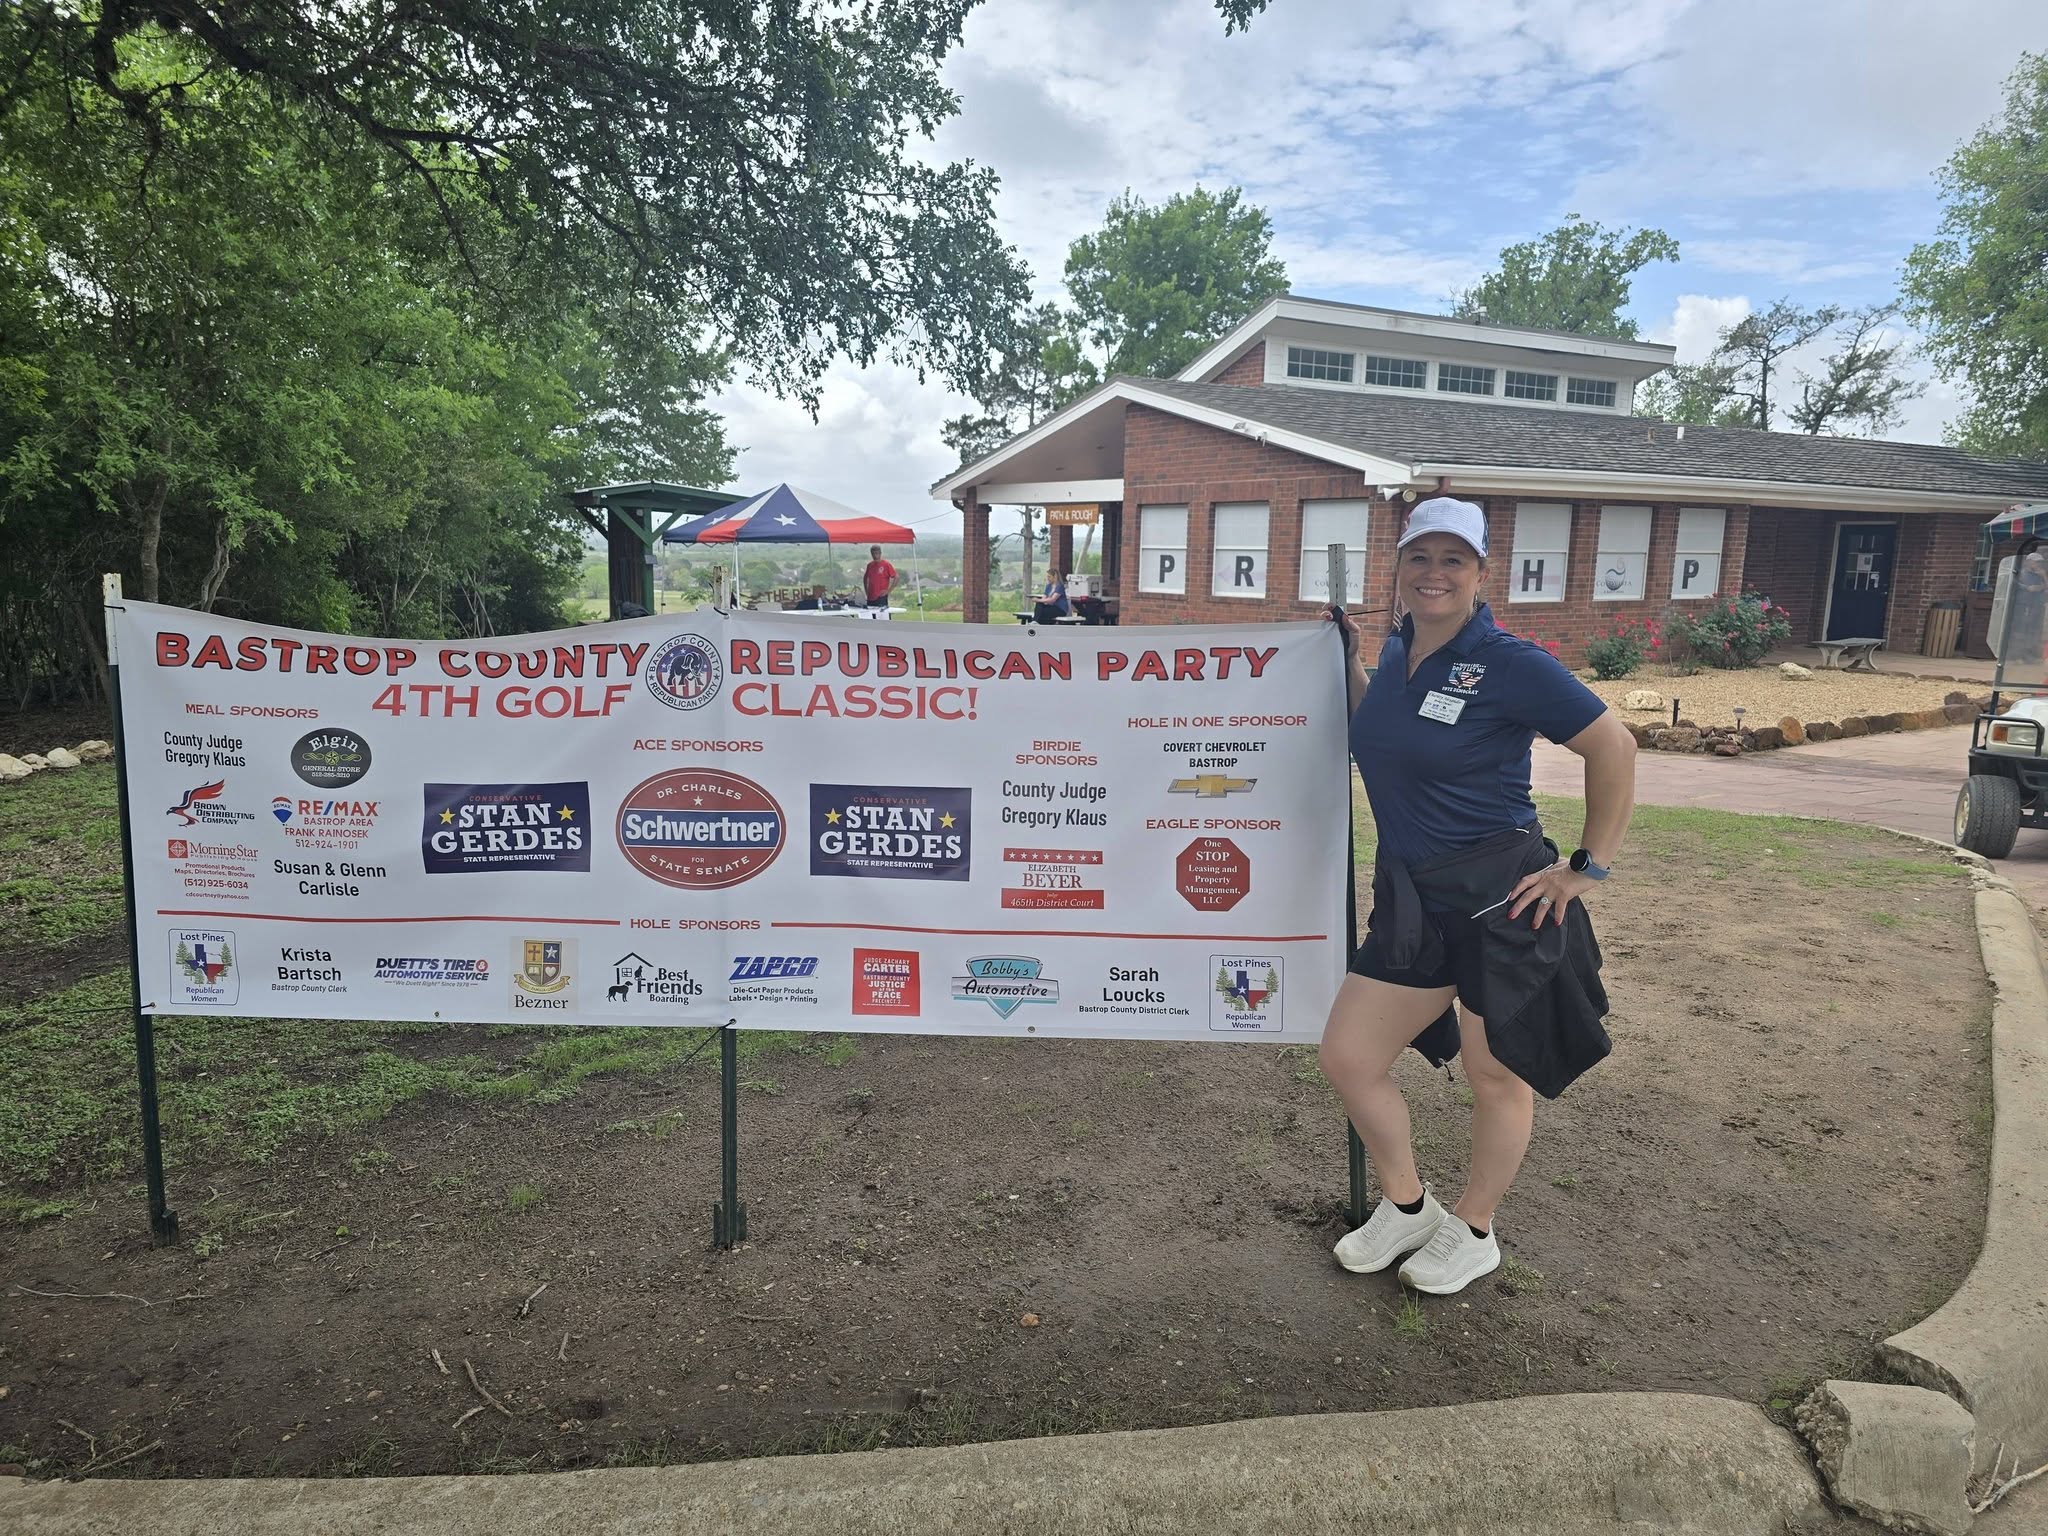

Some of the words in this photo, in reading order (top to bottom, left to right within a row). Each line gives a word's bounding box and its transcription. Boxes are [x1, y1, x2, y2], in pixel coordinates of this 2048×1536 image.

[1071, 510, 1093, 520] ROUGH
[1158, 555, 1175, 584] P
[1234, 556, 1254, 587] R
[1521, 559, 1544, 592] H
[1682, 559, 1699, 590] P
[156, 632, 416, 676] BASTROP
[439, 642, 650, 679] COUNTY
[730, 639, 1072, 681] REPUBLICAN
[1097, 647, 1279, 681] PARTY
[649, 636, 687, 672] BASTROP
[689, 637, 721, 673] COUNTY
[650, 682, 698, 708] REPUBLICAN
[698, 682, 717, 705] PARTY
[372, 684, 480, 718] 4TH
[495, 684, 632, 719] GOLF
[731, 682, 979, 721] CLASSIC!
[185, 703, 225, 716] MEAL
[229, 705, 319, 719] SPONSORS
[1128, 717, 1168, 728] HOLE
[1173, 717, 1187, 728] IN
[1191, 716, 1224, 728] ONE
[1228, 715, 1307, 727] SPONSOR
[164, 731, 203, 750] County
[207, 734, 243, 752] Judge
[308, 735, 359, 753] Elgin
[633, 739, 666, 750] ACE
[671, 740, 764, 752] SPONSORS
[1033, 740, 1082, 751] BIRDIE
[1163, 742, 1203, 752] COVERT
[1205, 741, 1266, 752] CHEVROLET
[165, 748, 210, 768] Gregory
[214, 751, 246, 767] Klaus
[1015, 754, 1098, 766] SPONSORS
[1189, 758, 1238, 768] BASTROP
[656, 788, 677, 799] DR.
[682, 784, 743, 800] CHARLES
[1002, 780, 1055, 802] County
[1059, 781, 1107, 803] Judge
[469, 794, 542, 802] CONSERVATIVE
[853, 796, 928, 805] CONSERVATIVE
[193, 801, 226, 810] BROWN
[298, 799, 379, 817] RE/MAX
[196, 810, 255, 820] DISTRIBUTING
[202, 816, 239, 825] COMPANY
[458, 802, 551, 828] STAN
[845, 805, 935, 831] STAN
[1002, 806, 1062, 829] Gregory
[1066, 808, 1107, 826] Klaus
[304, 817, 346, 826] BASTROP
[349, 818, 374, 827] AREA
[625, 814, 775, 842] Schwertner
[1146, 819, 1200, 830] EAGLE
[1203, 818, 1281, 831] SPONSOR
[285, 827, 315, 837] FRANK
[318, 828, 369, 838] RAINOSEK
[295, 838, 358, 850] 512-924-1901
[431, 826, 583, 854] GERDES
[819, 831, 962, 859] GERDES
[1204, 840, 1222, 848] One
[463, 855, 488, 863] STATE
[488, 854, 556, 862] REPRESENTATIVE
[1196, 851, 1230, 862] STOP
[185, 862, 220, 870] Promotional
[221, 864, 246, 872] Products
[273, 859, 320, 875] Susan
[325, 862, 336, 876] &
[340, 863, 387, 877] Glenn
[649, 854, 690, 875] STATE
[696, 855, 750, 875] SENATE
[870, 860, 934, 869] REPRESENTATIVE
[1028, 864, 1077, 873] ELIZABETH
[1188, 864, 1220, 874] Leasing
[1222, 865, 1238, 873] and
[228, 870, 256, 878] Brochures
[1195, 875, 1231, 885] Property
[184, 879, 207, 888] (512)
[207, 880, 249, 889] 925-6034
[1022, 873, 1083, 888] BEYER
[299, 880, 360, 897] Carlisle
[1185, 885, 1241, 895] Management,
[1011, 898, 1034, 907] 465th
[1036, 898, 1068, 907] District
[1070, 898, 1094, 907] Court
[1203, 896, 1223, 904] LLC
[630, 918, 671, 929] HOLE
[678, 919, 761, 930] SPONSORS
[180, 932, 200, 942] Lost
[202, 933, 225, 943] Pines
[281, 948, 332, 962] Krista
[443, 959, 475, 971] TIRE
[729, 956, 819, 983] ZAPCO
[863, 963, 910, 974] CARTER
[1221, 958, 1242, 968] Lost
[1245, 959, 1272, 969] Pines
[277, 966, 341, 981] Bartsch
[374, 970, 445, 980] AUTOMOTIVE
[444, 971, 489, 981] SERVICE
[658, 967, 689, 982] Best
[981, 961, 1029, 980] Bobby's
[1109, 966, 1159, 982] Sarah
[271, 983, 300, 992] Bastrop
[301, 984, 327, 993] County
[328, 985, 347, 993] Clerk
[637, 977, 703, 995] Friends
[868, 980, 906, 988] JUSTICE
[962, 979, 1048, 997] Automotive
[186, 986, 225, 995] Republican
[733, 986, 761, 994] Die-Cut
[762, 987, 782, 995] Paper
[783, 987, 814, 995] Products
[872, 991, 902, 999] PEACE
[1103, 987, 1166, 1003] Loucks
[514, 994, 569, 1009] Bezner
[649, 994, 689, 1005] Boarding
[759, 995, 784, 1003] Design
[790, 996, 818, 1004] Printing
[1079, 1005, 1109, 1014] Bastrop
[1110, 1006, 1137, 1015] County
[1139, 1006, 1167, 1015] District
[1169, 1007, 1190, 1016] Clerk
[1225, 1013, 1266, 1022] Republican
